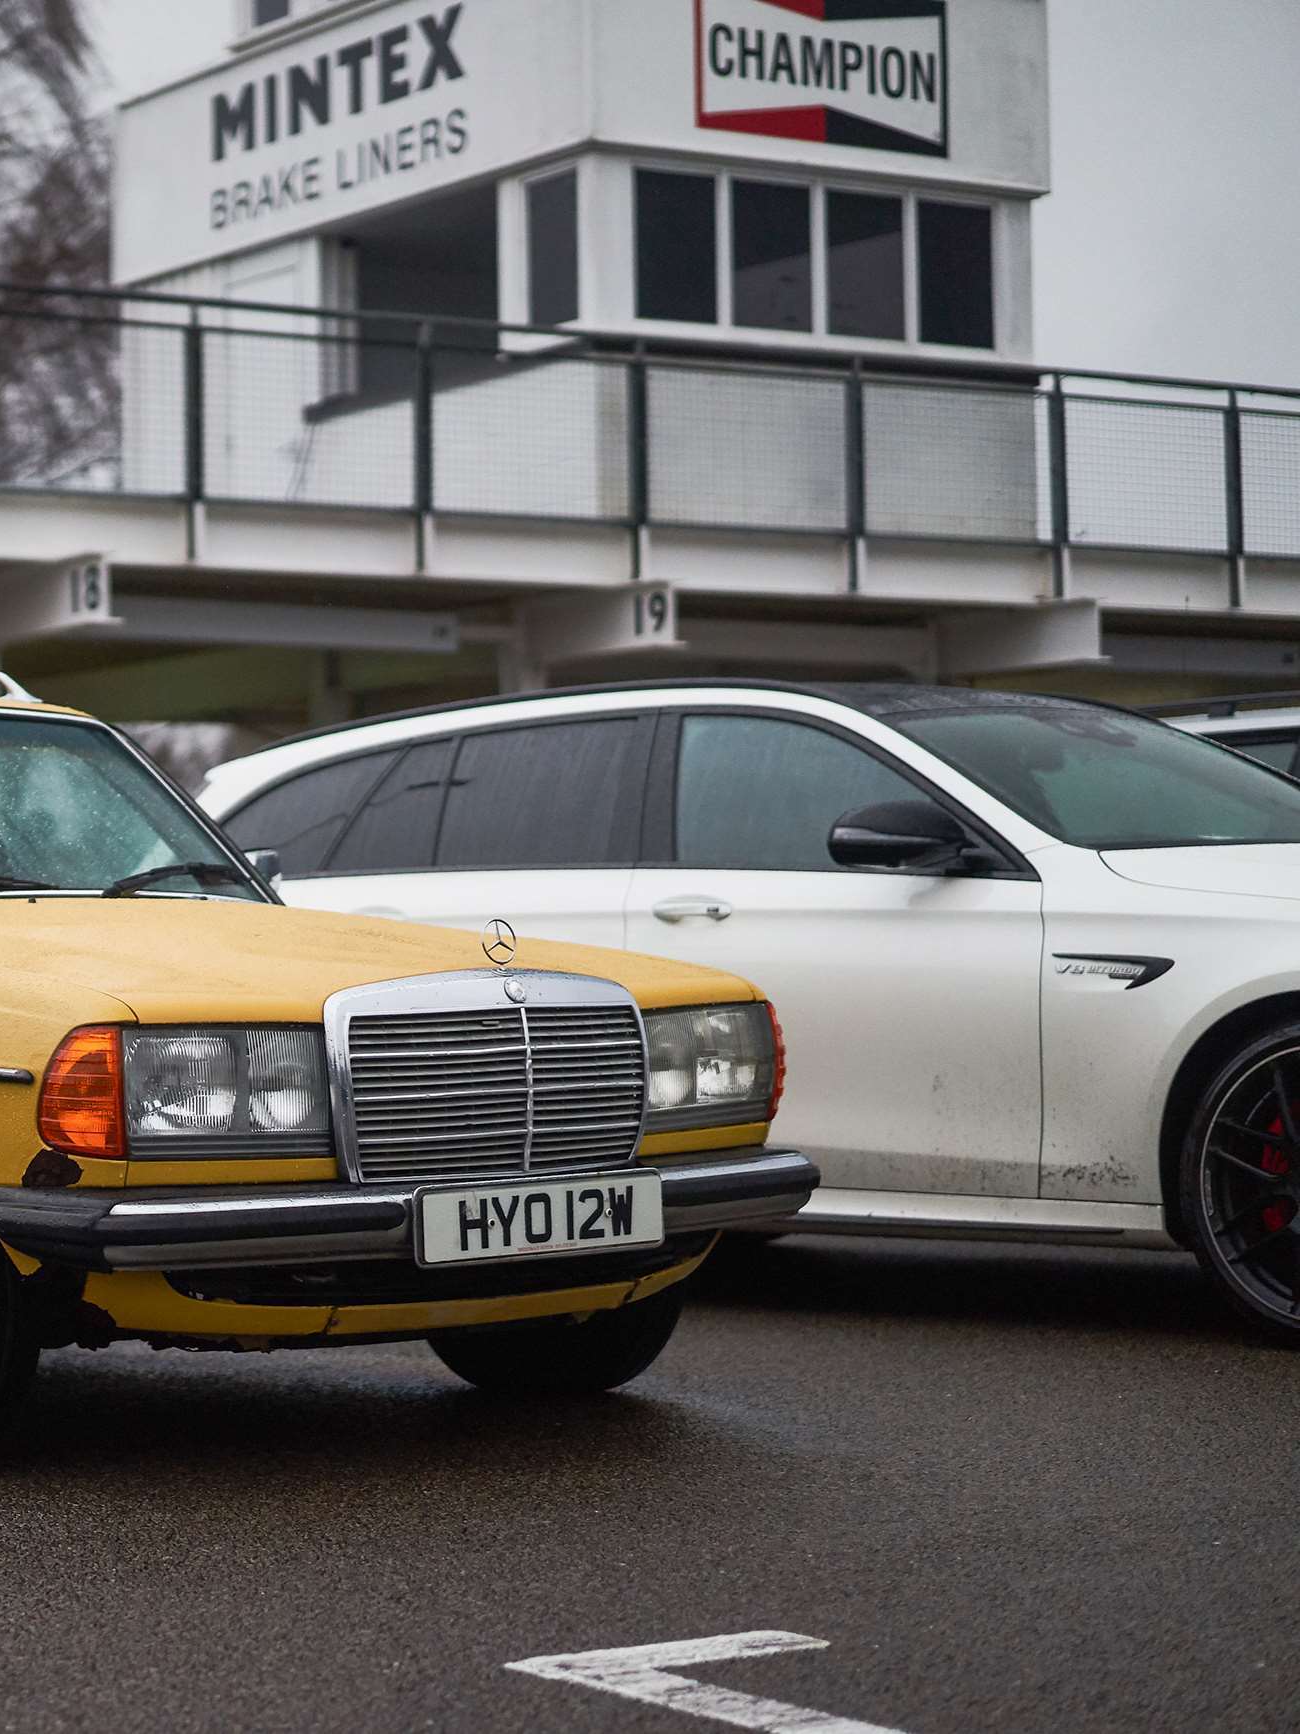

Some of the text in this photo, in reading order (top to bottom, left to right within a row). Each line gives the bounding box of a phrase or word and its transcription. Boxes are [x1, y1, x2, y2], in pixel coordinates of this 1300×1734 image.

[210, 3, 468, 162] MINTEX
[708, 22, 937, 104] CHAMPION
[209, 107, 469, 231] BRAKE LINERS
[70, 566, 100, 612] 18
[635, 591, 667, 636] 19
[458, 1185, 634, 1251] HYO 12W
